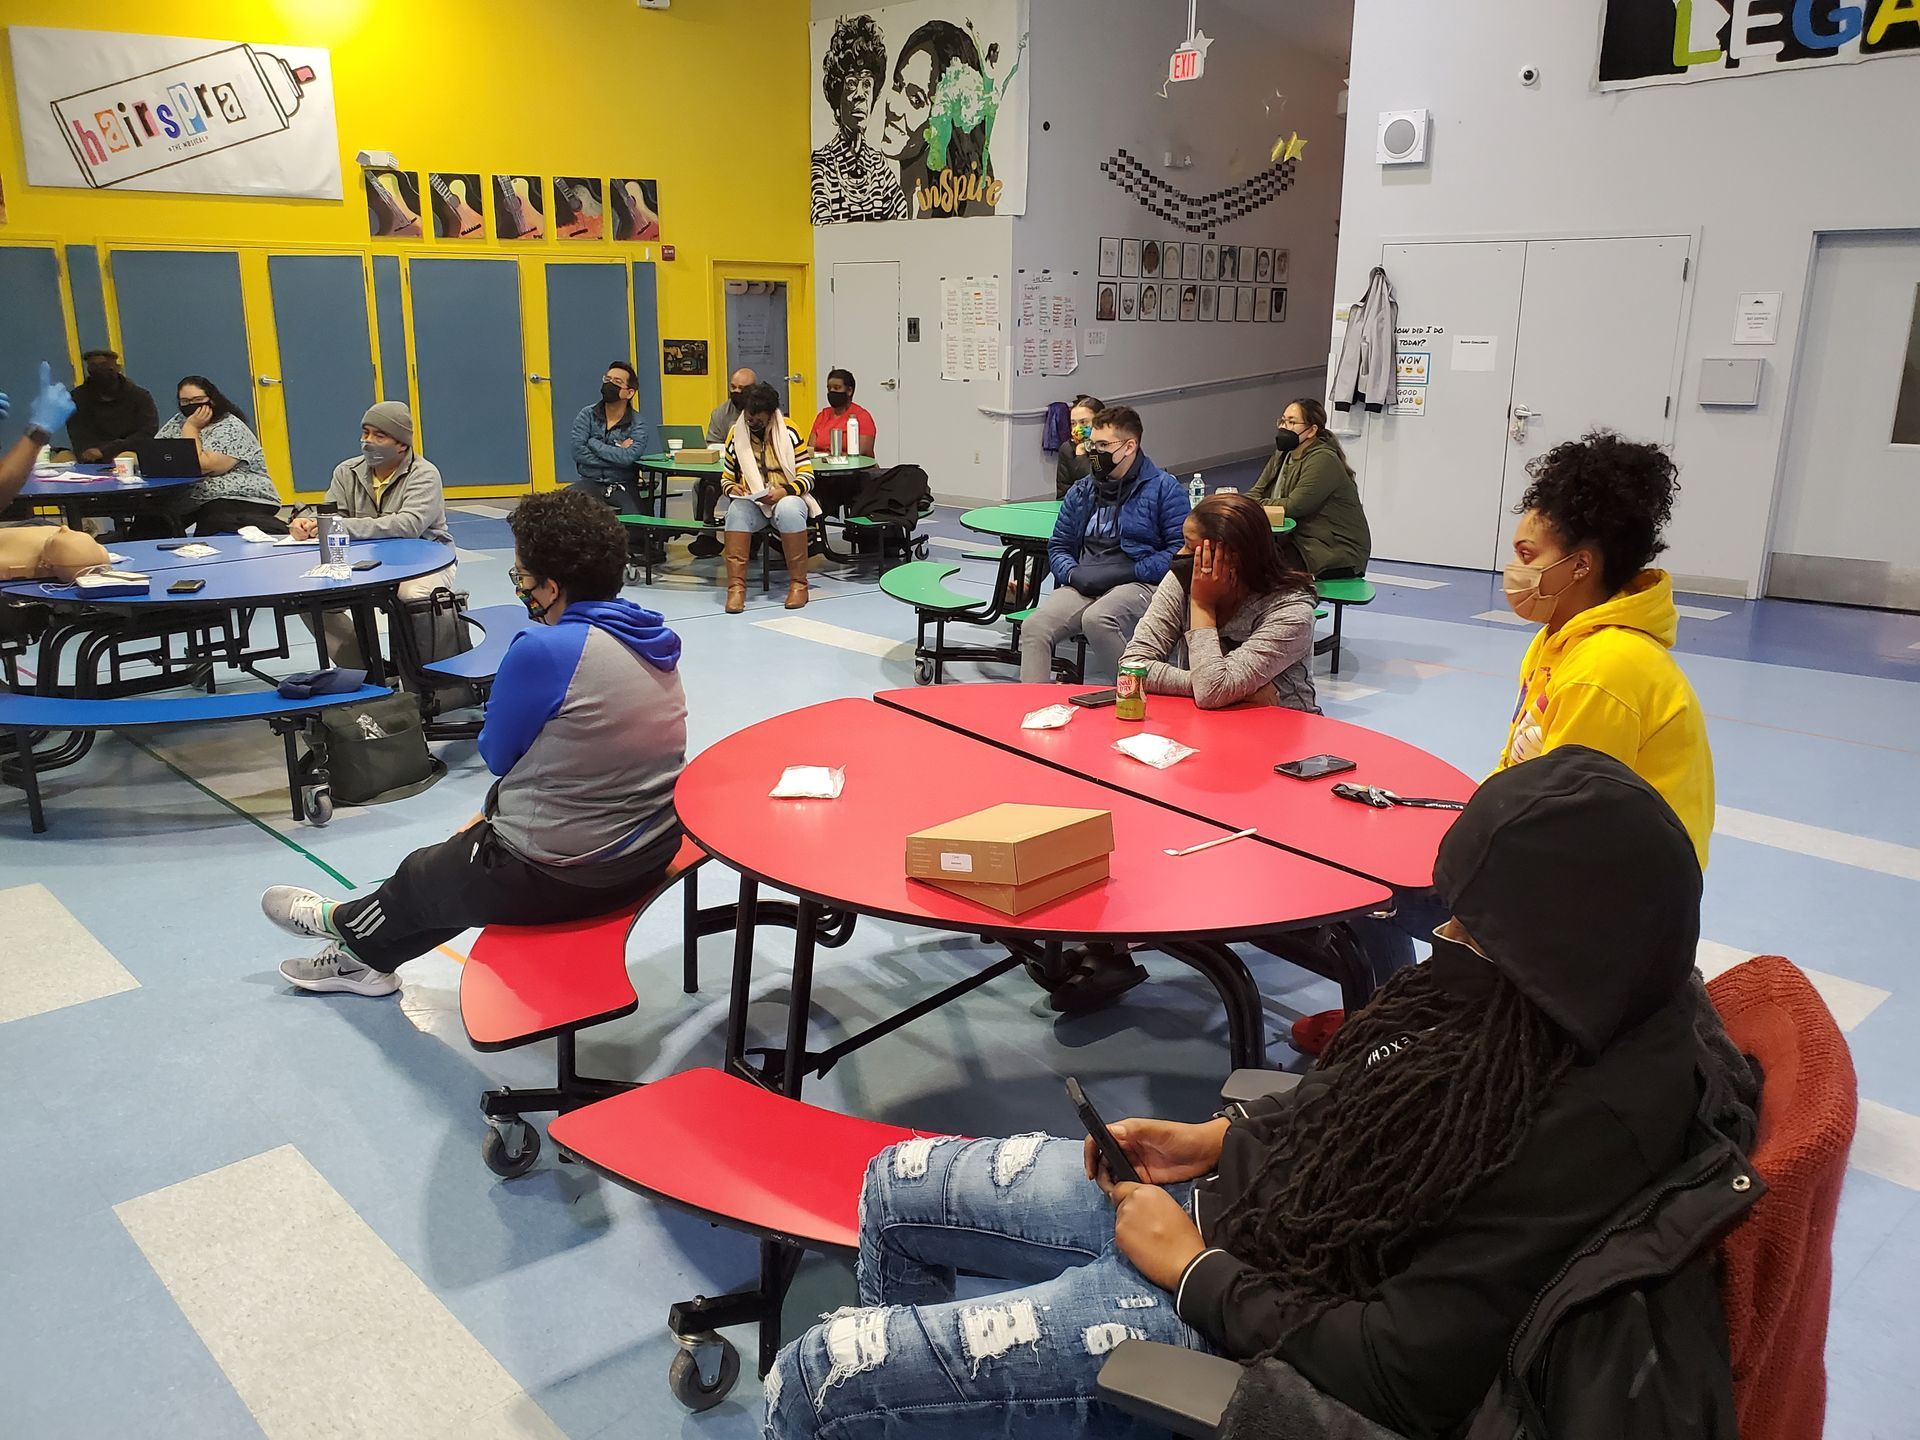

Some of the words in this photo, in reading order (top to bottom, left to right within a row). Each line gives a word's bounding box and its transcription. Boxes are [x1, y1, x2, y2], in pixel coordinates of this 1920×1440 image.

[1174, 53, 1197, 79] EXIT
[72, 82, 247, 166] hairspra
[1425, 326, 1432, 334] I
[1399, 339, 1427, 347] TODAY?
[1399, 356, 1421, 364] WOW
